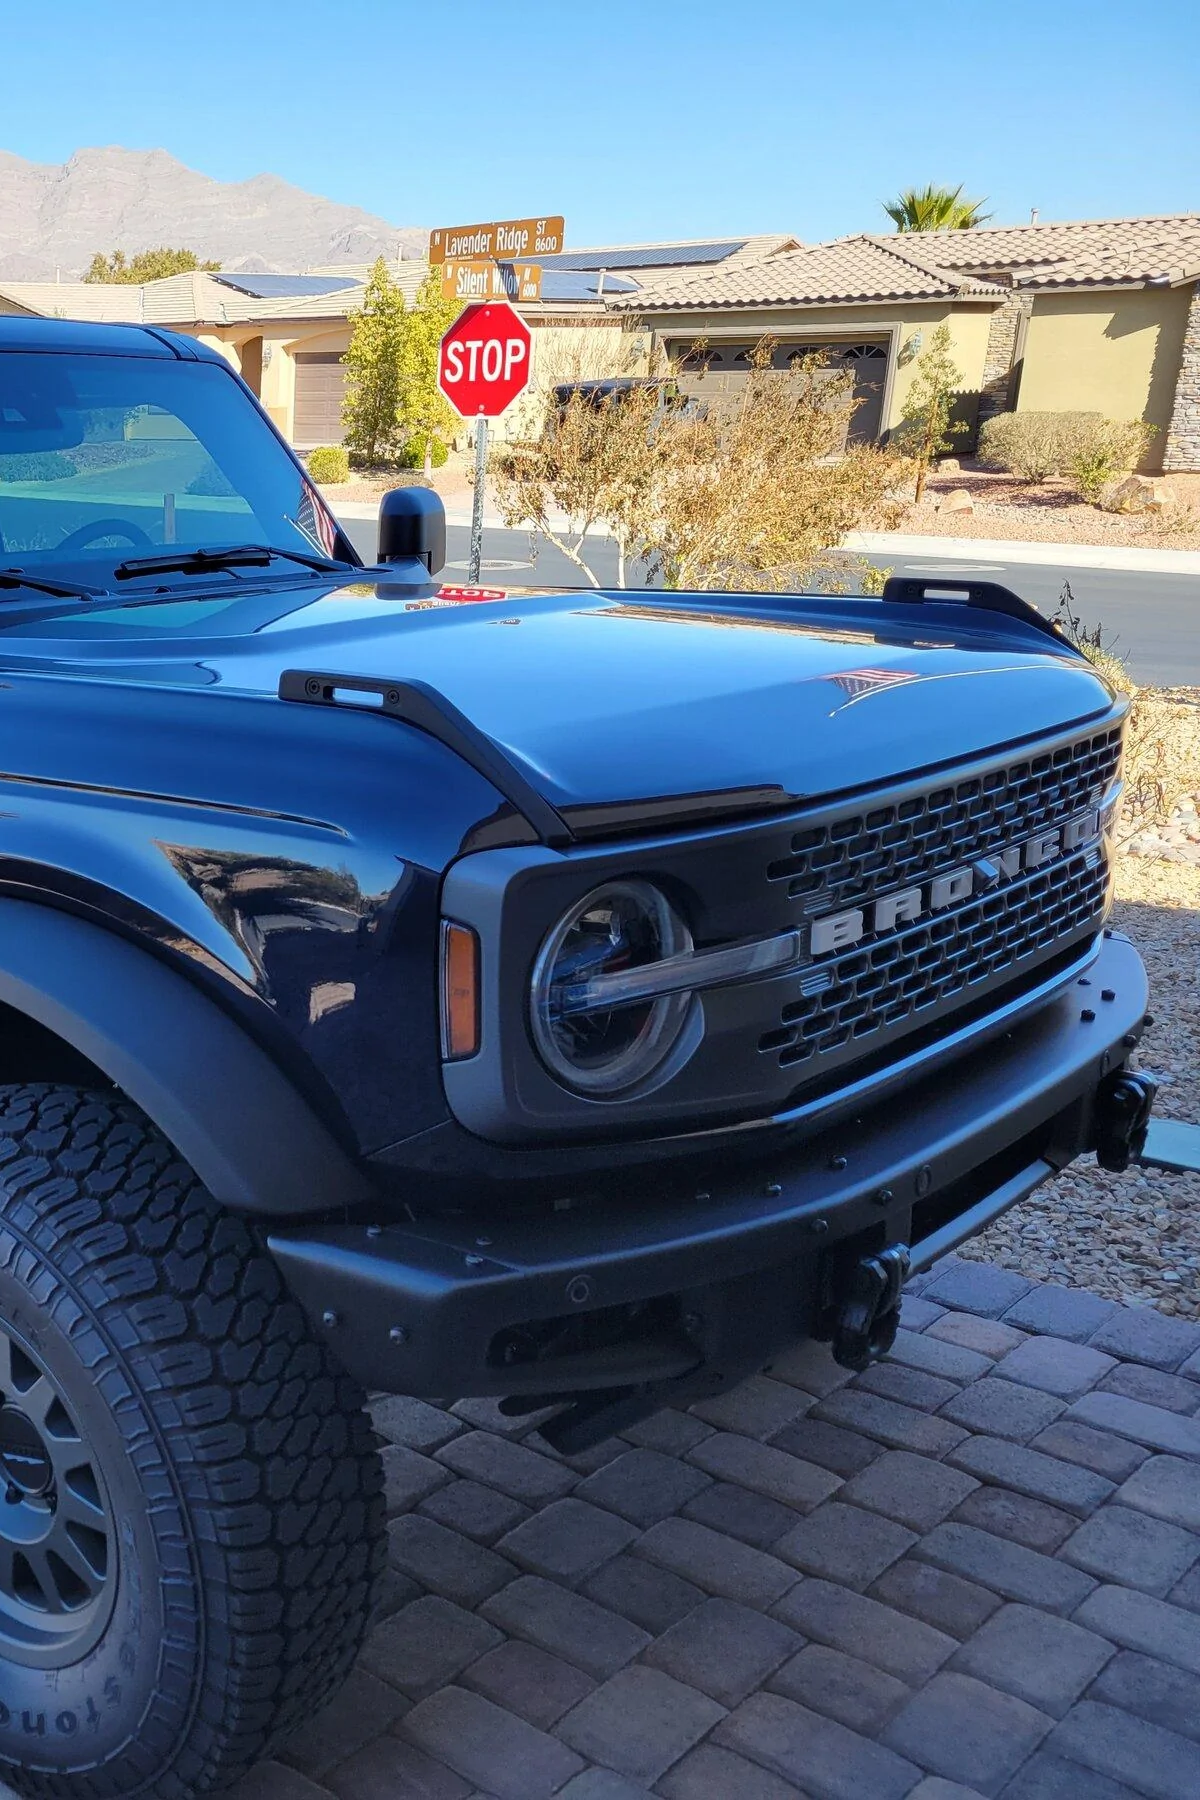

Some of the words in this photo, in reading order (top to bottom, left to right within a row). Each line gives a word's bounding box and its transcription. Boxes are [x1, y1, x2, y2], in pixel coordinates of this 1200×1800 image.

[445, 230, 492, 256] Lavender
[496, 226, 529, 257] Ridge
[535, 220, 547, 235] ST
[534, 236, 557, 252] 8600
[456, 266, 489, 294] Silent
[444, 338, 526, 384] STOP
[810, 808, 1099, 956] BRONCO
